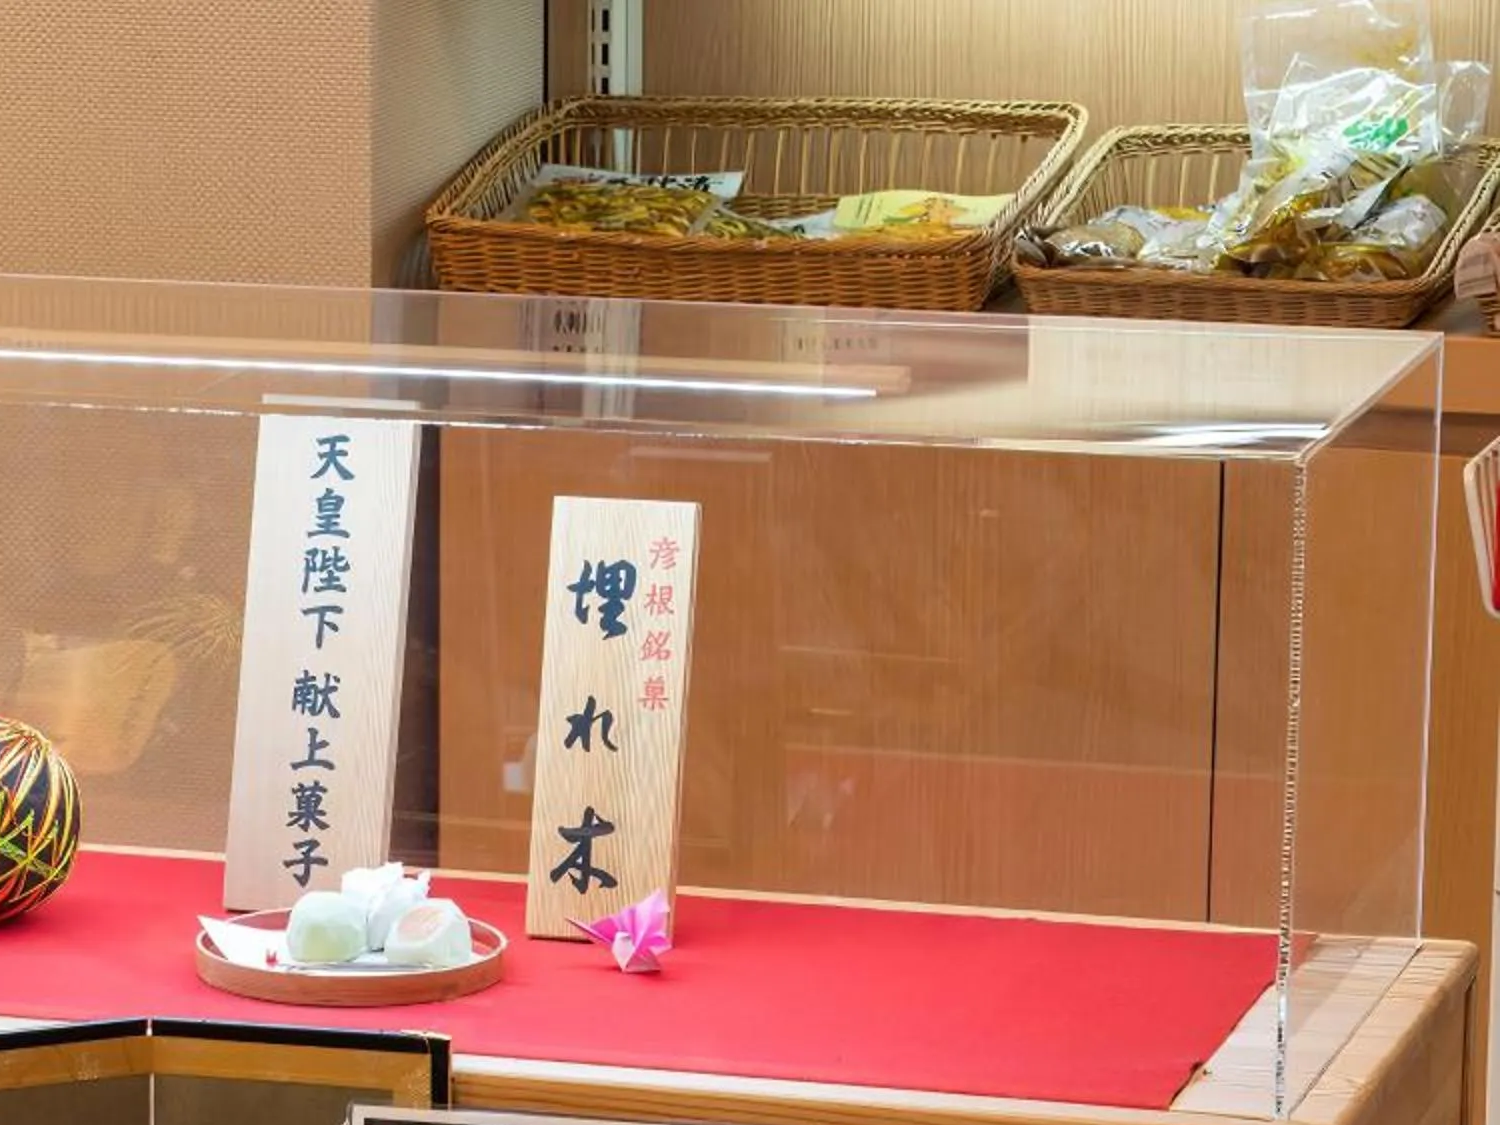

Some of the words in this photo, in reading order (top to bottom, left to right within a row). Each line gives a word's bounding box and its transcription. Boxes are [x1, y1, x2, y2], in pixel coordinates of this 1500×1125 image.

[301, 434, 356, 649] 天皇陛下
[637, 536, 681, 711] 彦根銘菓
[282, 669, 341, 887] 献上菓子
[549, 559, 638, 895] 埋れ木
